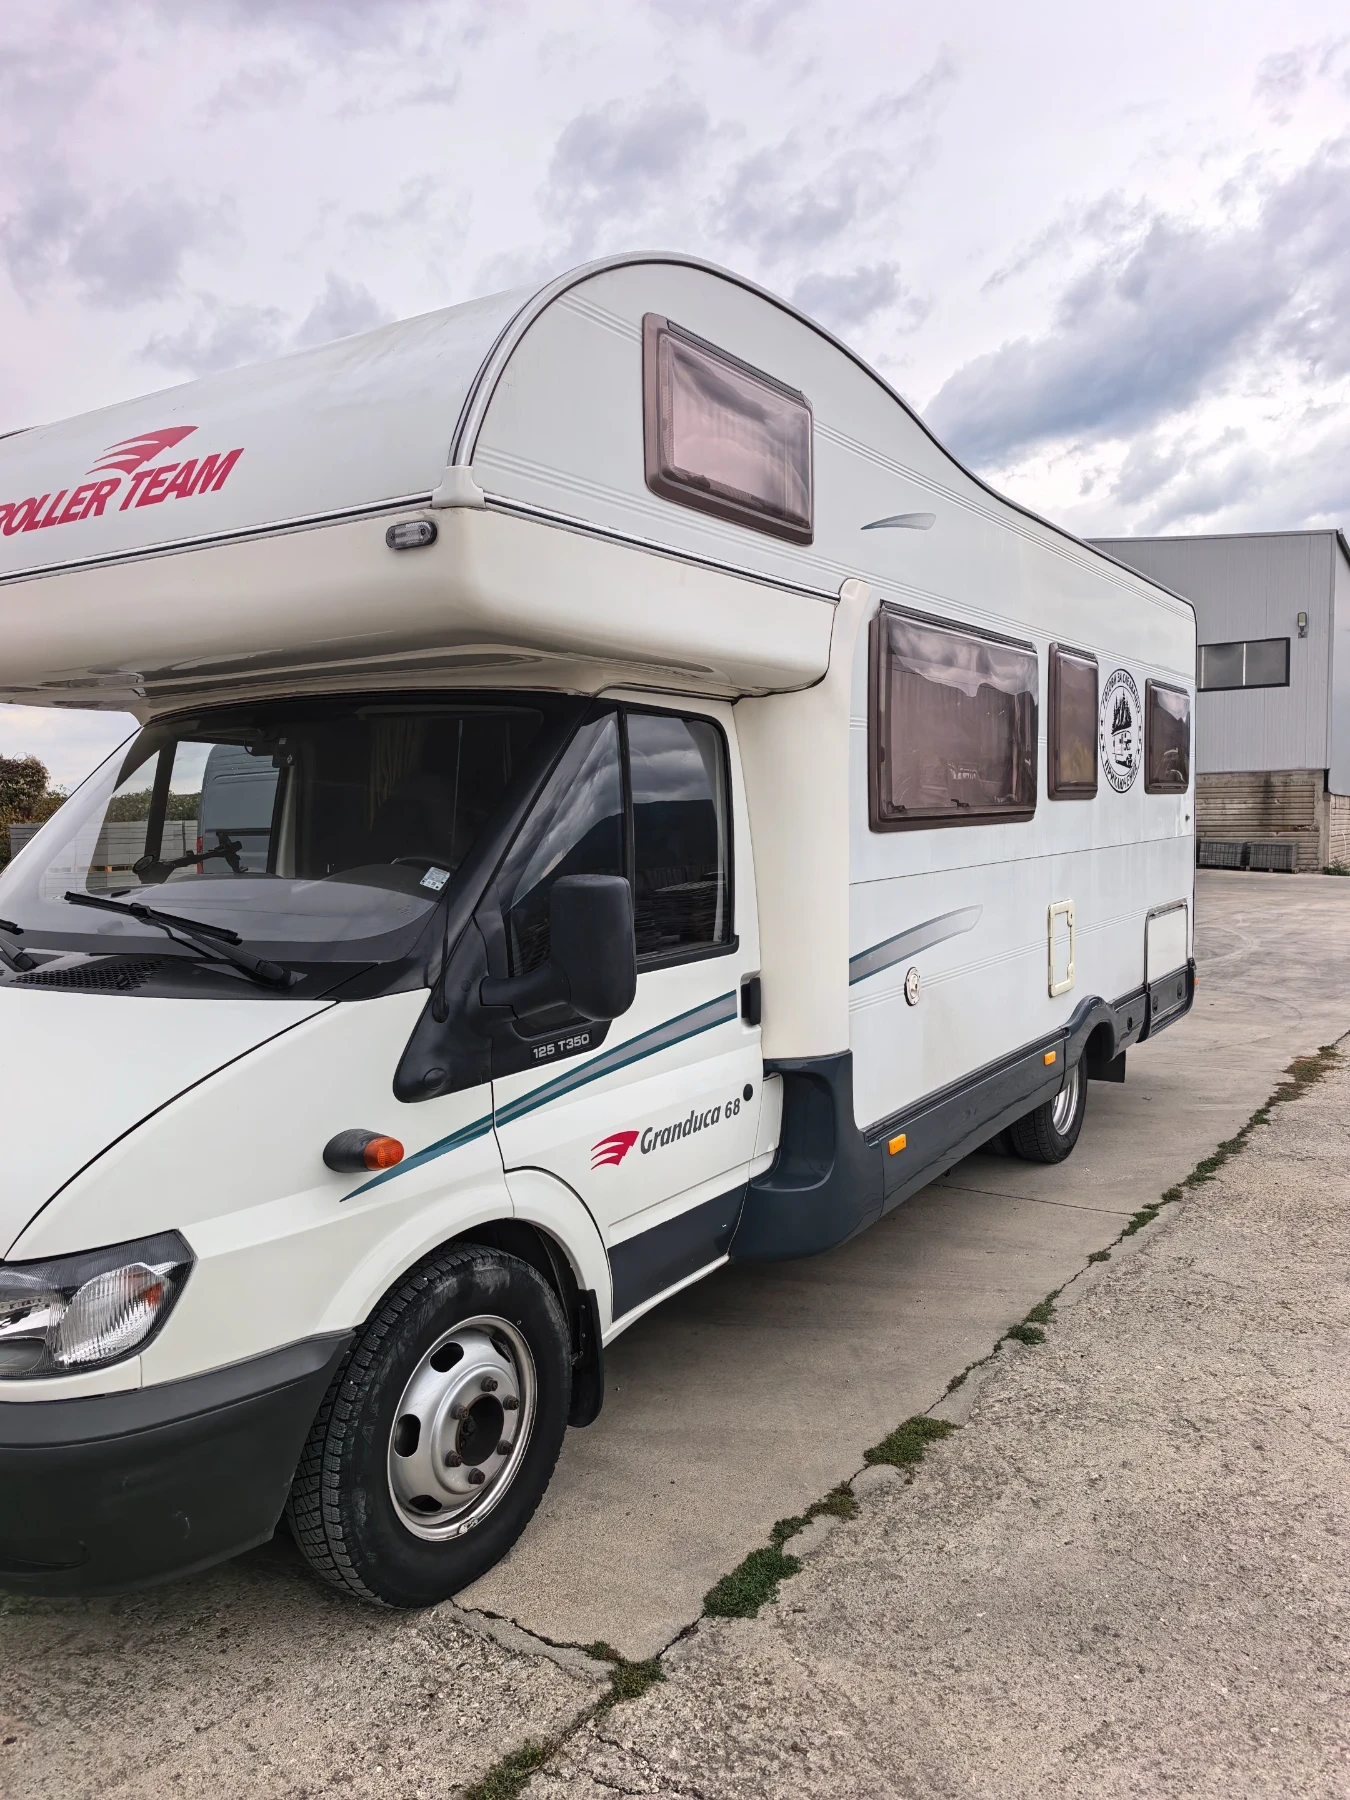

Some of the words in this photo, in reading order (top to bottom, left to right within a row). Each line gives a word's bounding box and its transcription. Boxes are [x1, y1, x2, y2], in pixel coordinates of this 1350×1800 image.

[0, 477, 121, 536] OLLER
[119, 448, 244, 511] TEAM
[533, 1044, 555, 1059] 125
[558, 1033, 590, 1051] T350
[640, 1109, 721, 1155] Granduca
[724, 1098, 740, 1119] 68
